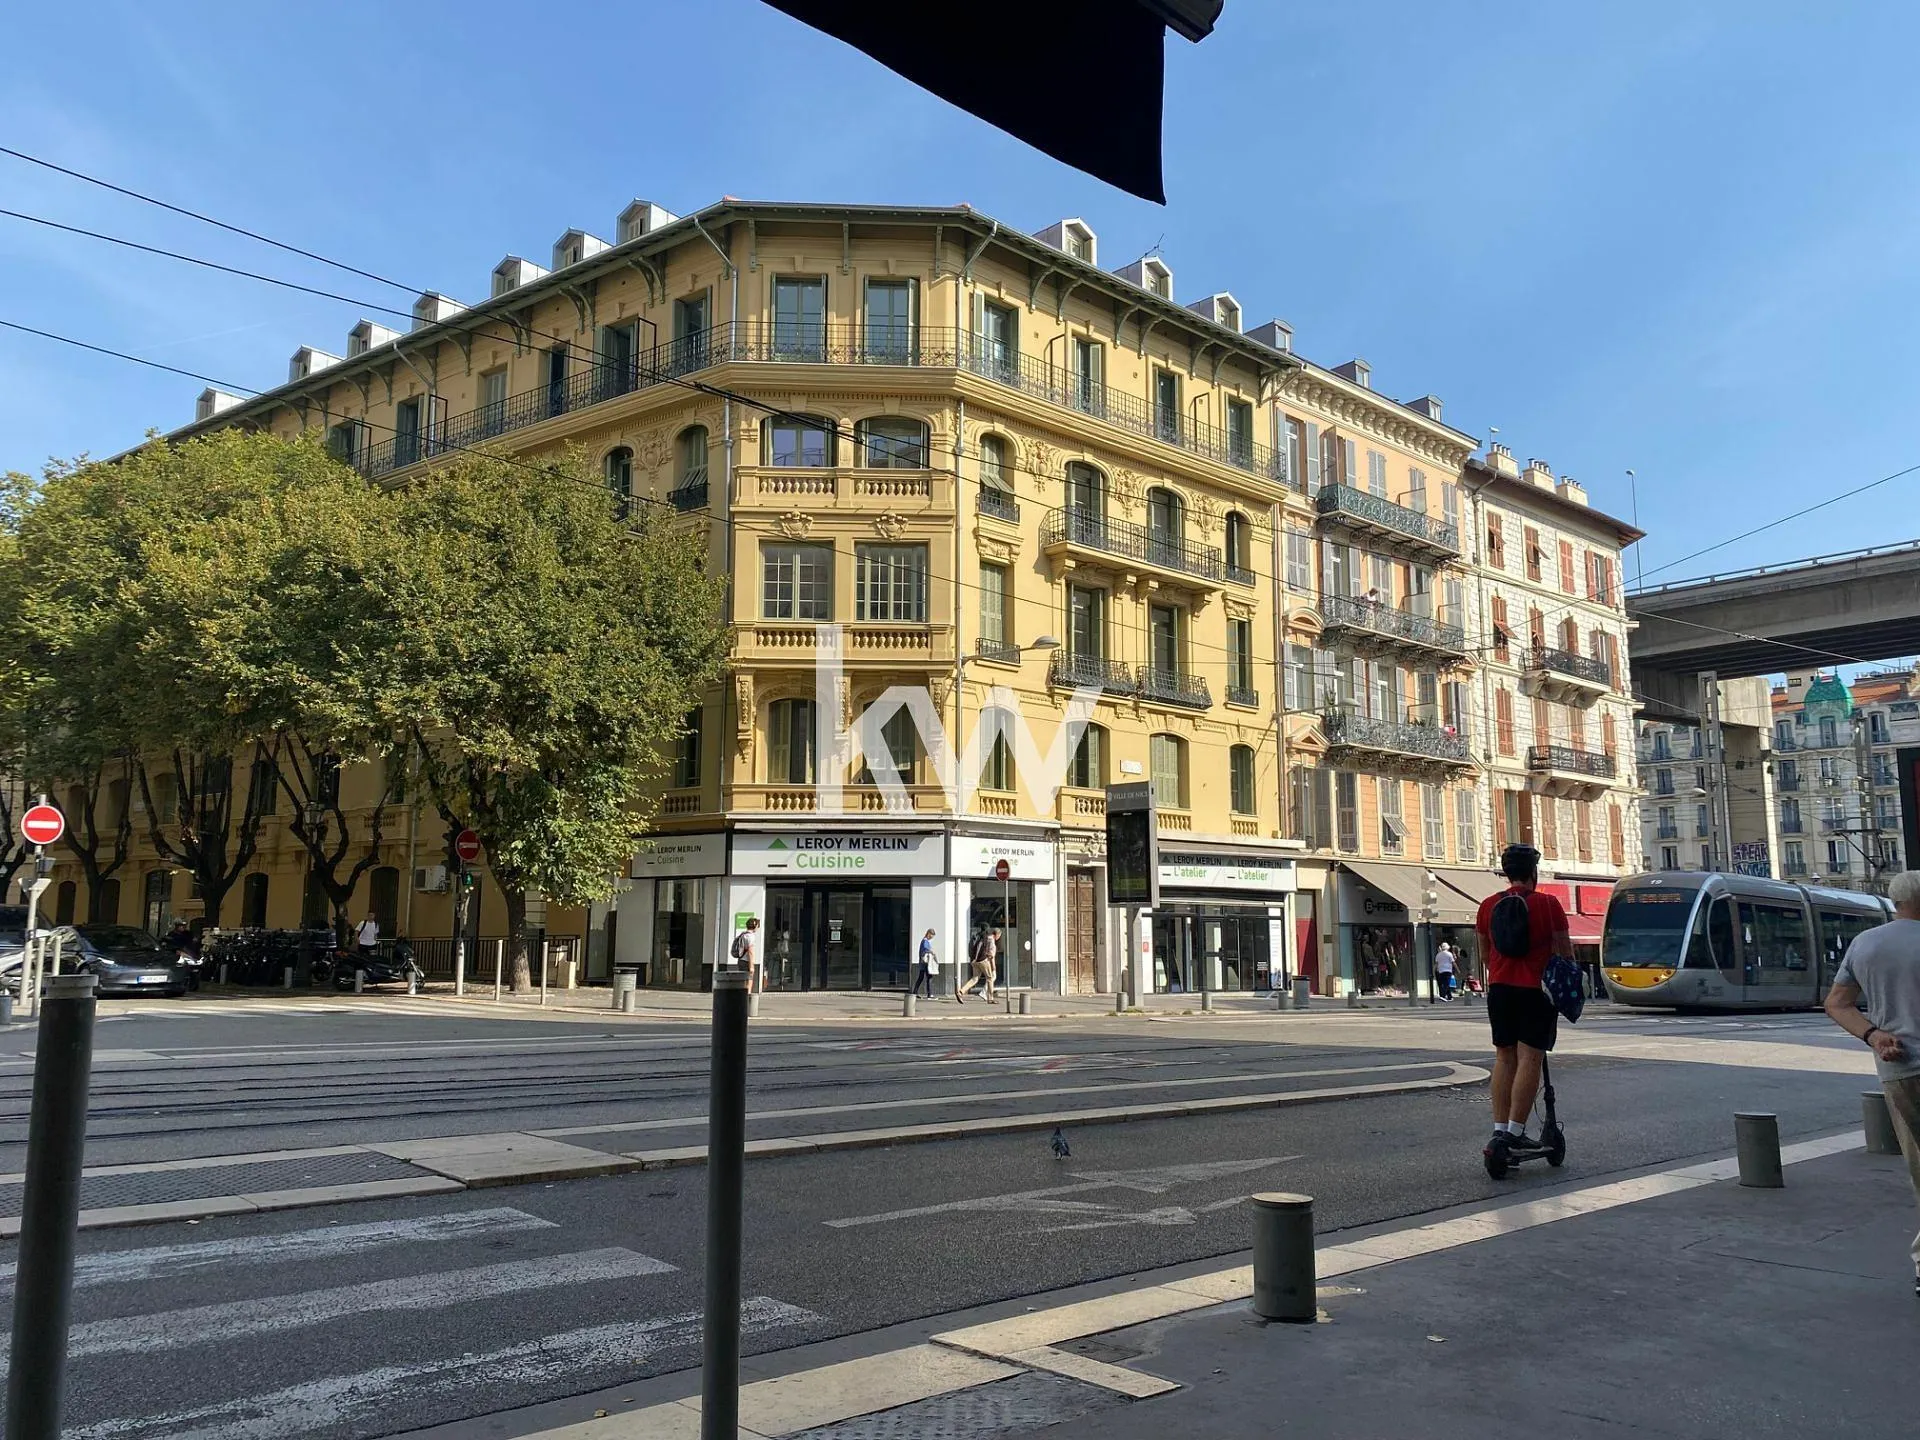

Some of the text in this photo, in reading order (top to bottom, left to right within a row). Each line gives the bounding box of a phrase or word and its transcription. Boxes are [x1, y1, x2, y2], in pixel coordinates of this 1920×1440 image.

[796, 837, 908, 850] LEROY MERLIN
[657, 845, 702, 854] LEROY MERLIN
[991, 847, 1035, 857] LEROY MERLIN
[657, 855, 685, 865] Cuisine
[796, 852, 865, 869] Cuisine
[1173, 855, 1222, 866] LEROY MERLIN
[1237, 859, 1282, 869] LEROY MERLIN
[1174, 866, 1207, 878] L'atelier
[1237, 869, 1268, 881] L'atelier
